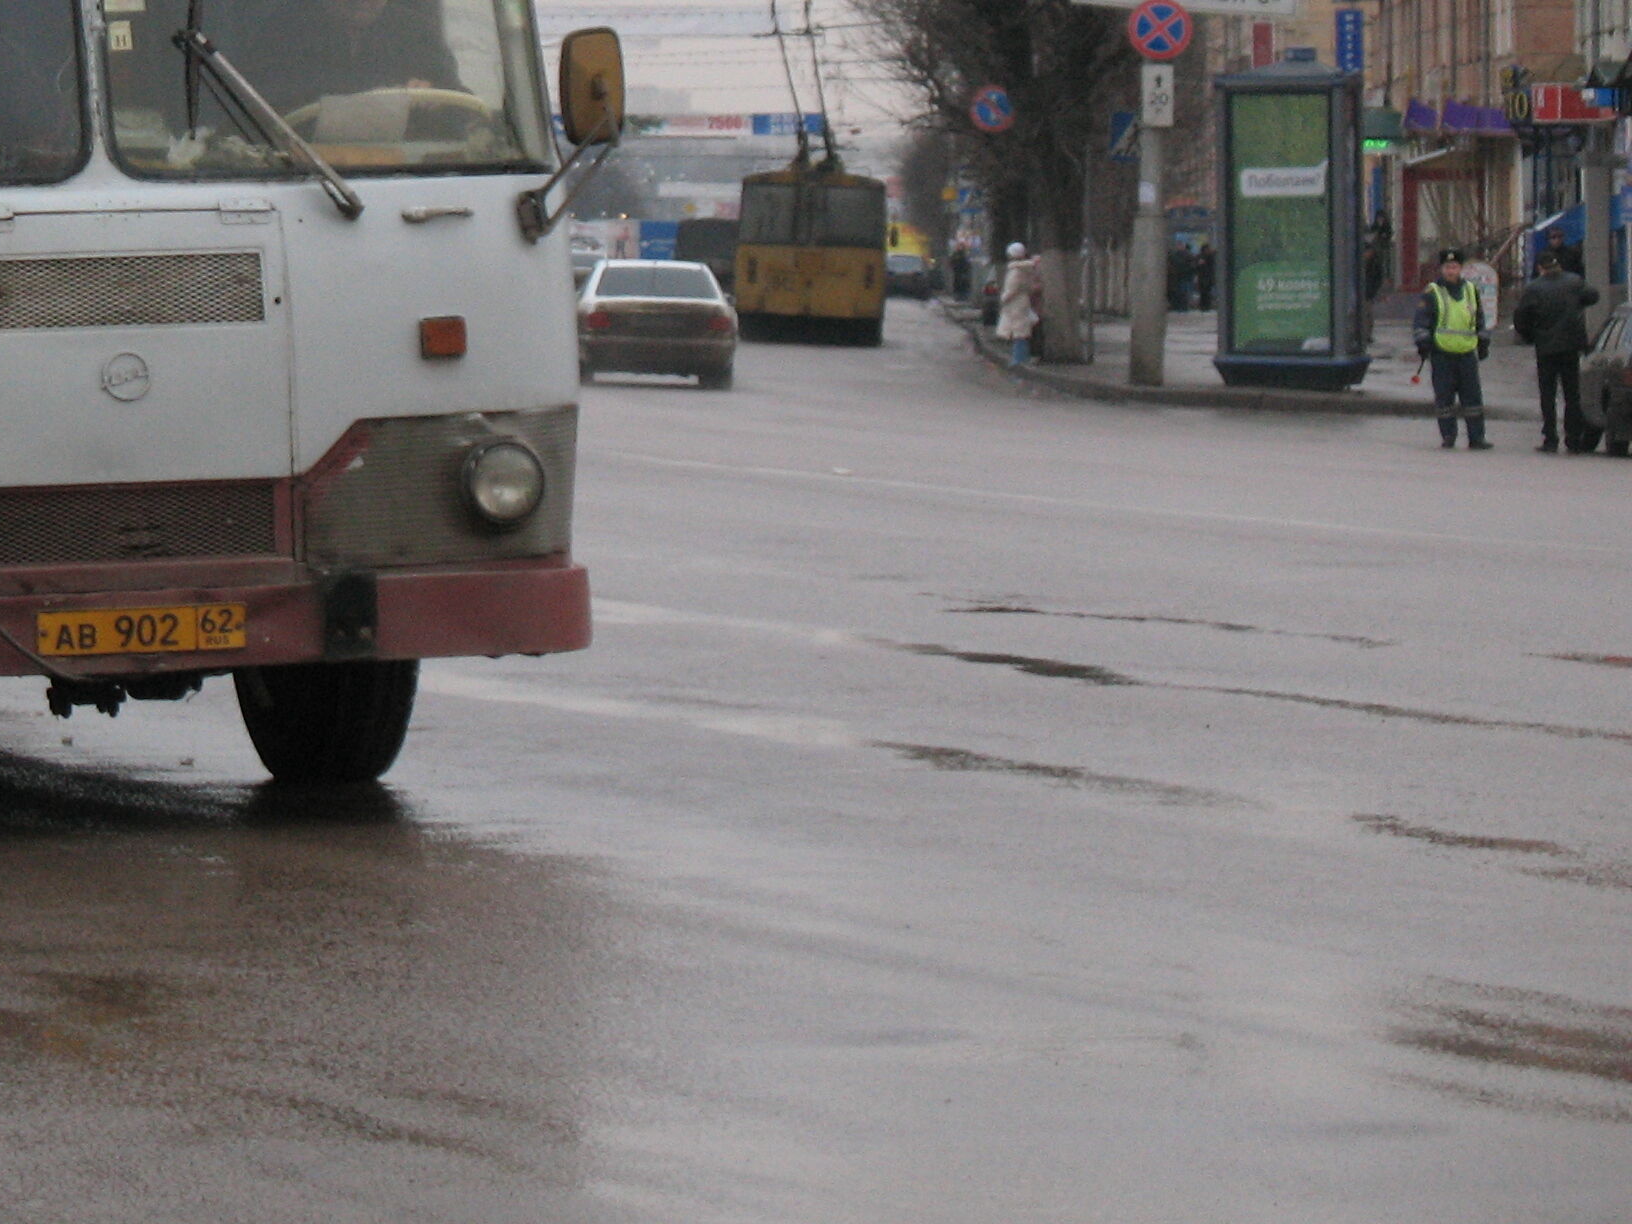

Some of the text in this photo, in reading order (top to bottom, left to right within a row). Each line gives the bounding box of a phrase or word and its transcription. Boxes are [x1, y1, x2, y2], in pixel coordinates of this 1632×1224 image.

[55, 608, 234, 651] АВ 902 62
